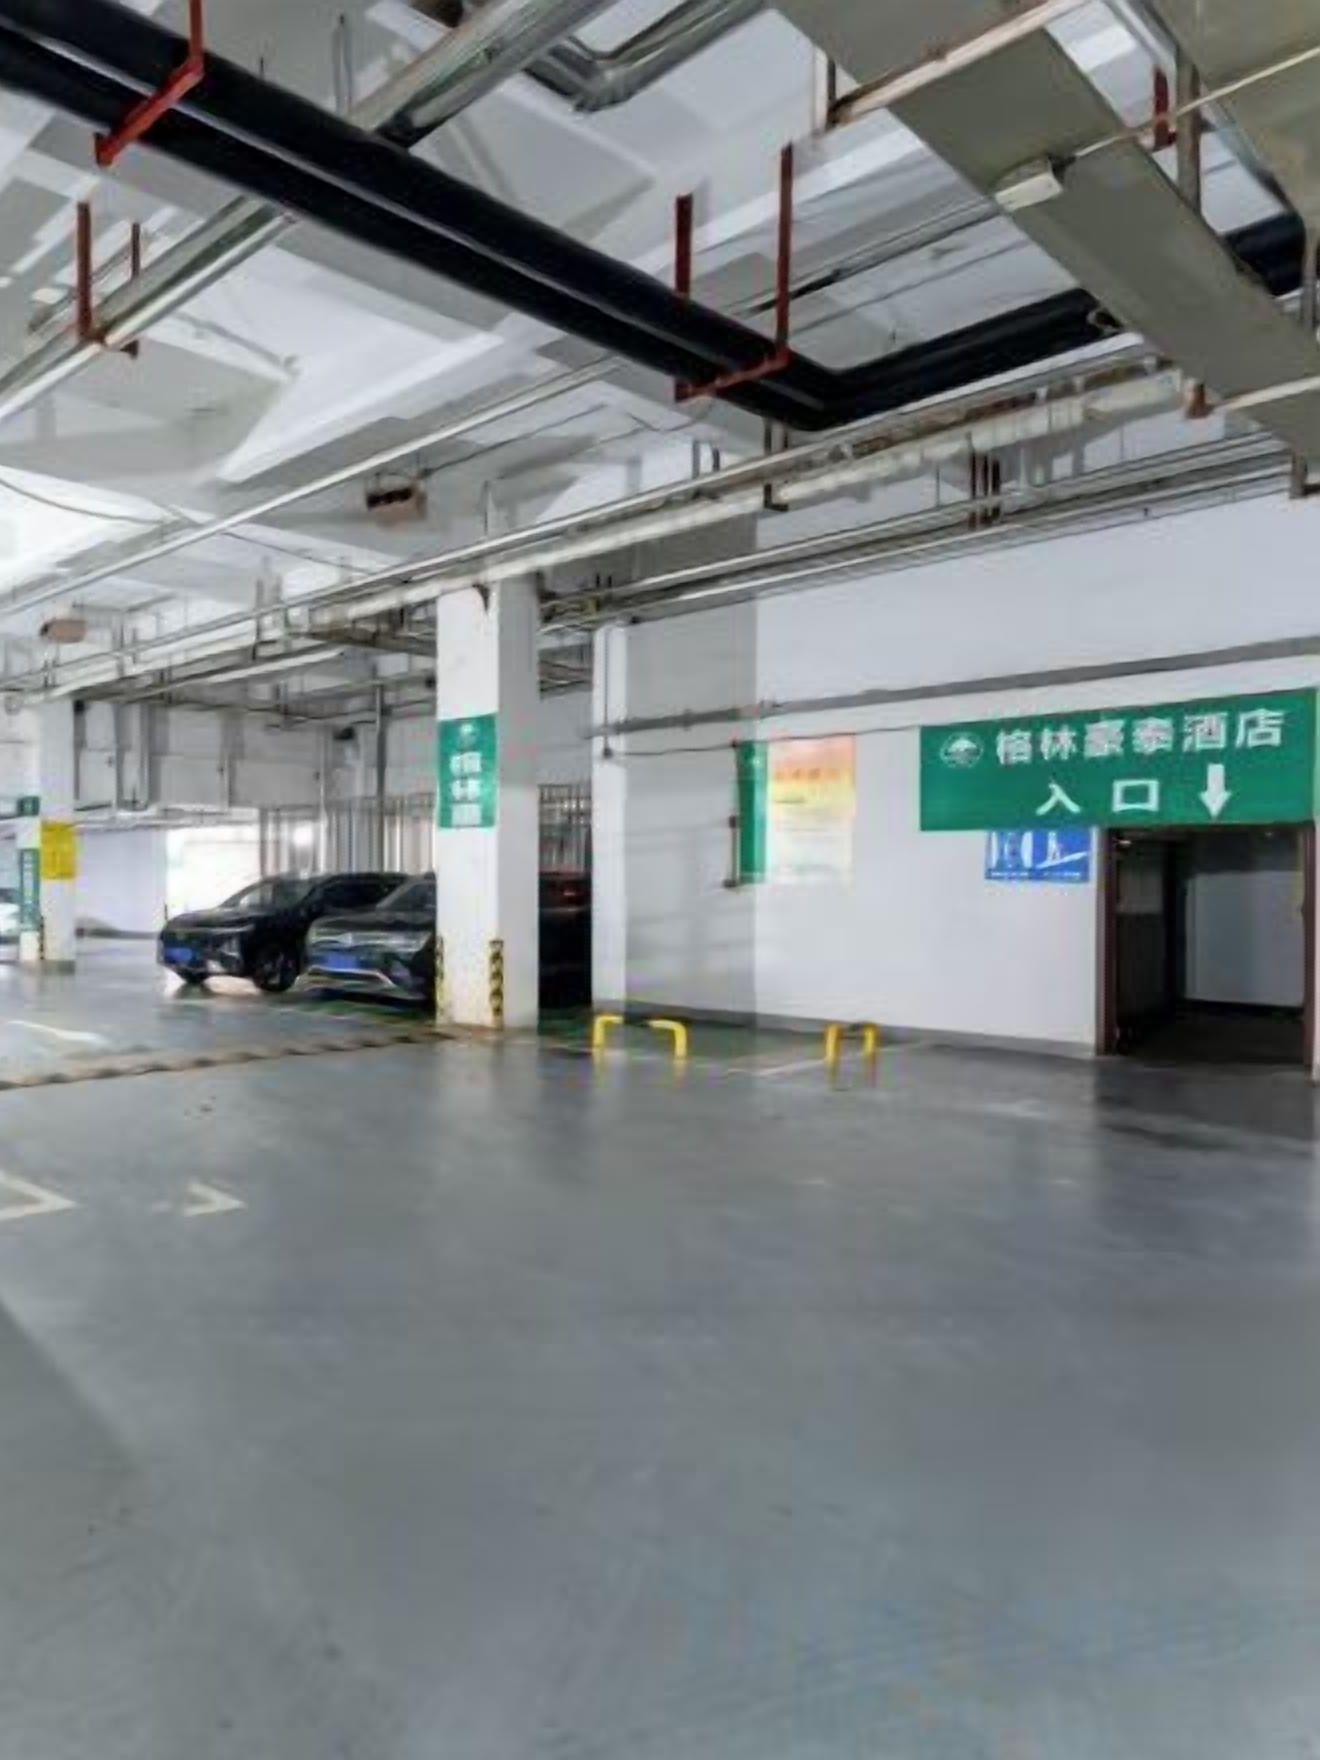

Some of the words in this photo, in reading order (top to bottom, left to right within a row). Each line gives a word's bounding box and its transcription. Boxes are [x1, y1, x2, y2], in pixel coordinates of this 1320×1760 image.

[995, 708, 1284, 766] 格林豪泰酒店
[1035, 776, 1160, 817] 入口
